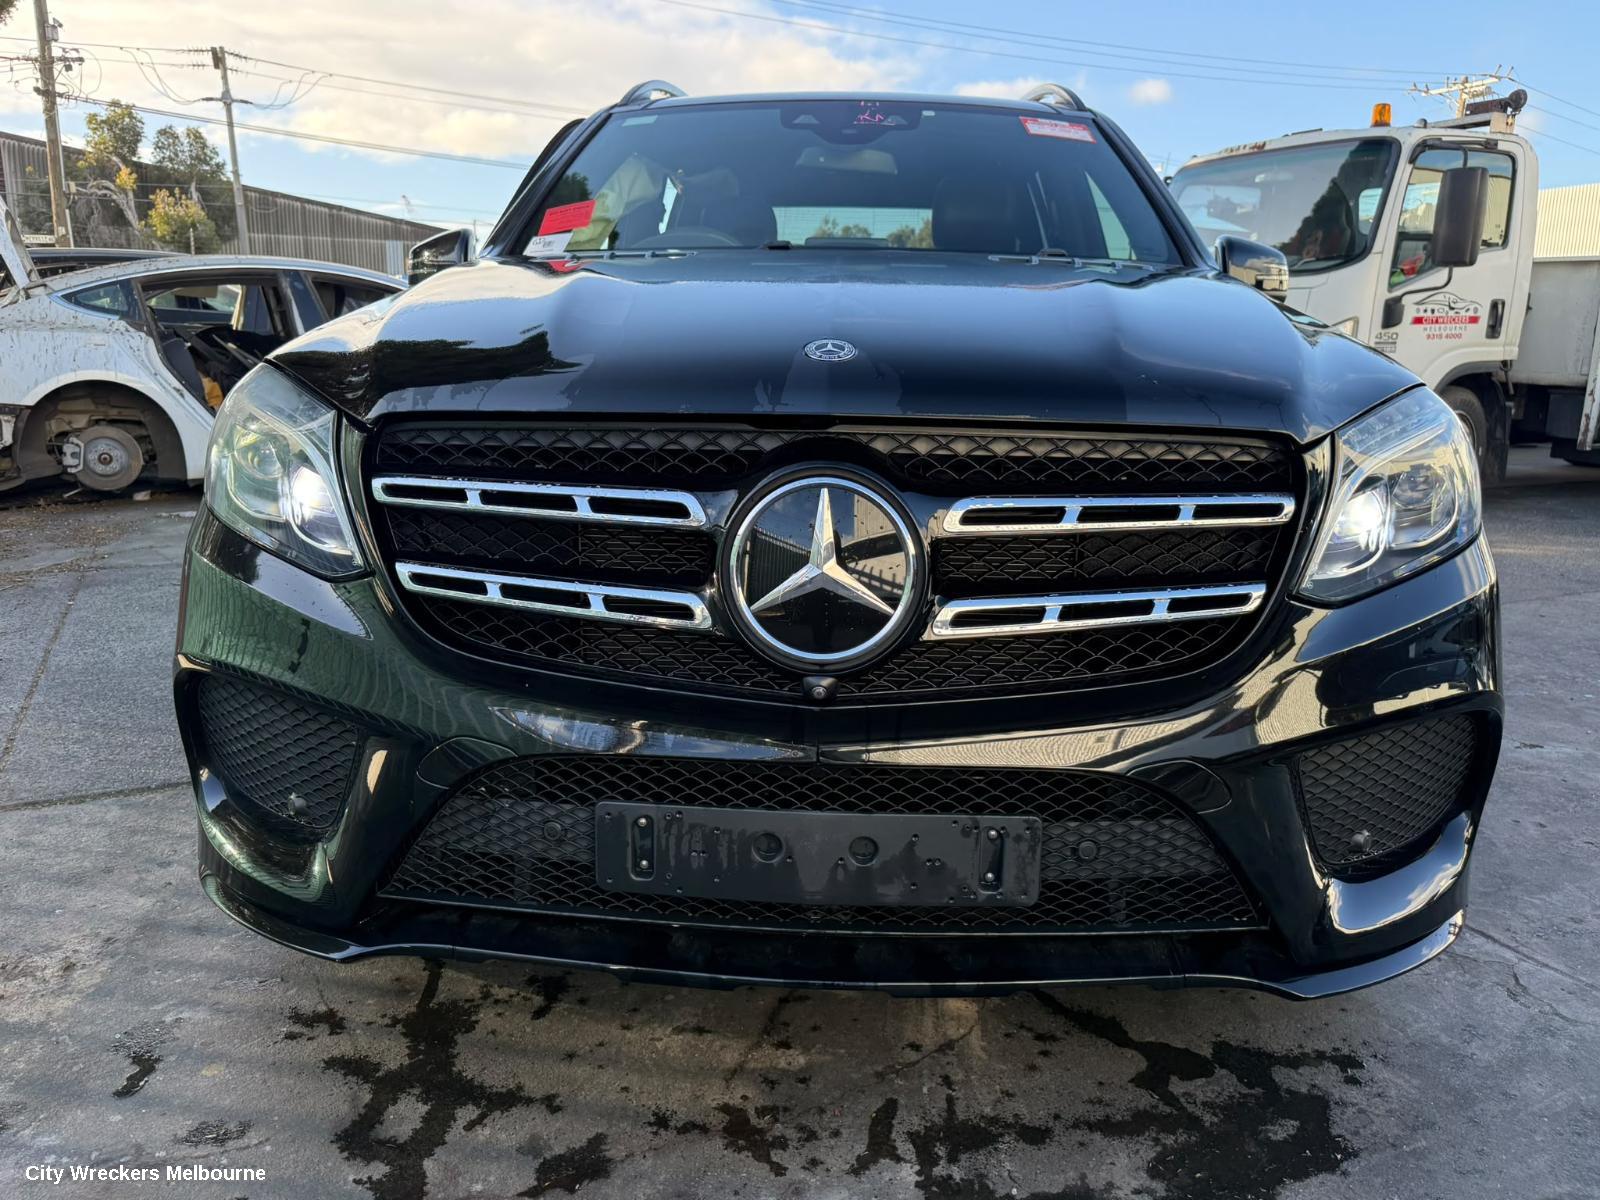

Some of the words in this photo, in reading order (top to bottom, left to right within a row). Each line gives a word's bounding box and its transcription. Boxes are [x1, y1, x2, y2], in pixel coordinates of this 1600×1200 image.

[1422, 316, 1437, 324] CITY
[1438, 316, 1469, 324] WRECKERS
[1374, 331, 1399, 340] 450
